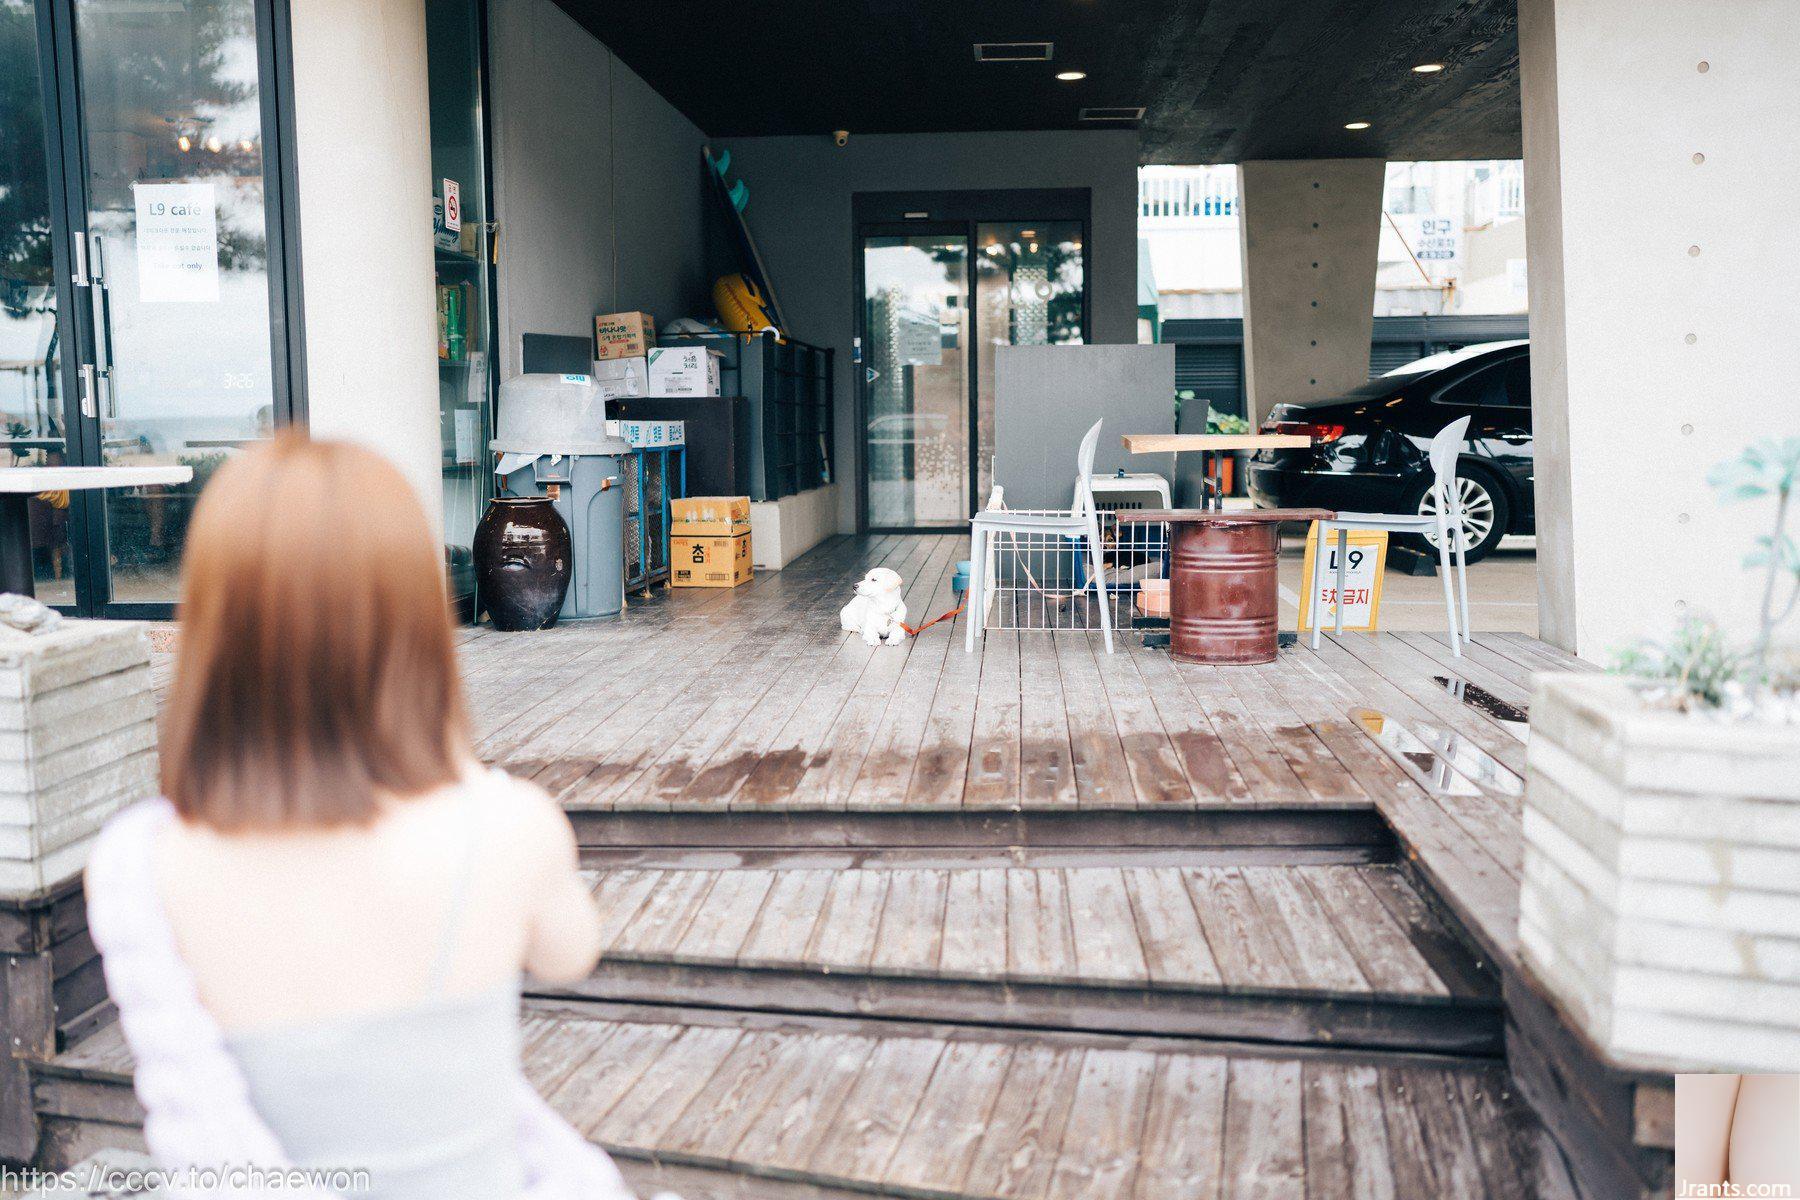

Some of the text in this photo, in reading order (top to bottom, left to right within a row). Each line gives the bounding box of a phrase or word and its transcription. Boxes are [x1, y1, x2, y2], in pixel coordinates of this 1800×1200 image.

[149, 202, 166, 216] L9
[186, 262, 203, 270] only
[1329, 550, 1364, 570] L9
